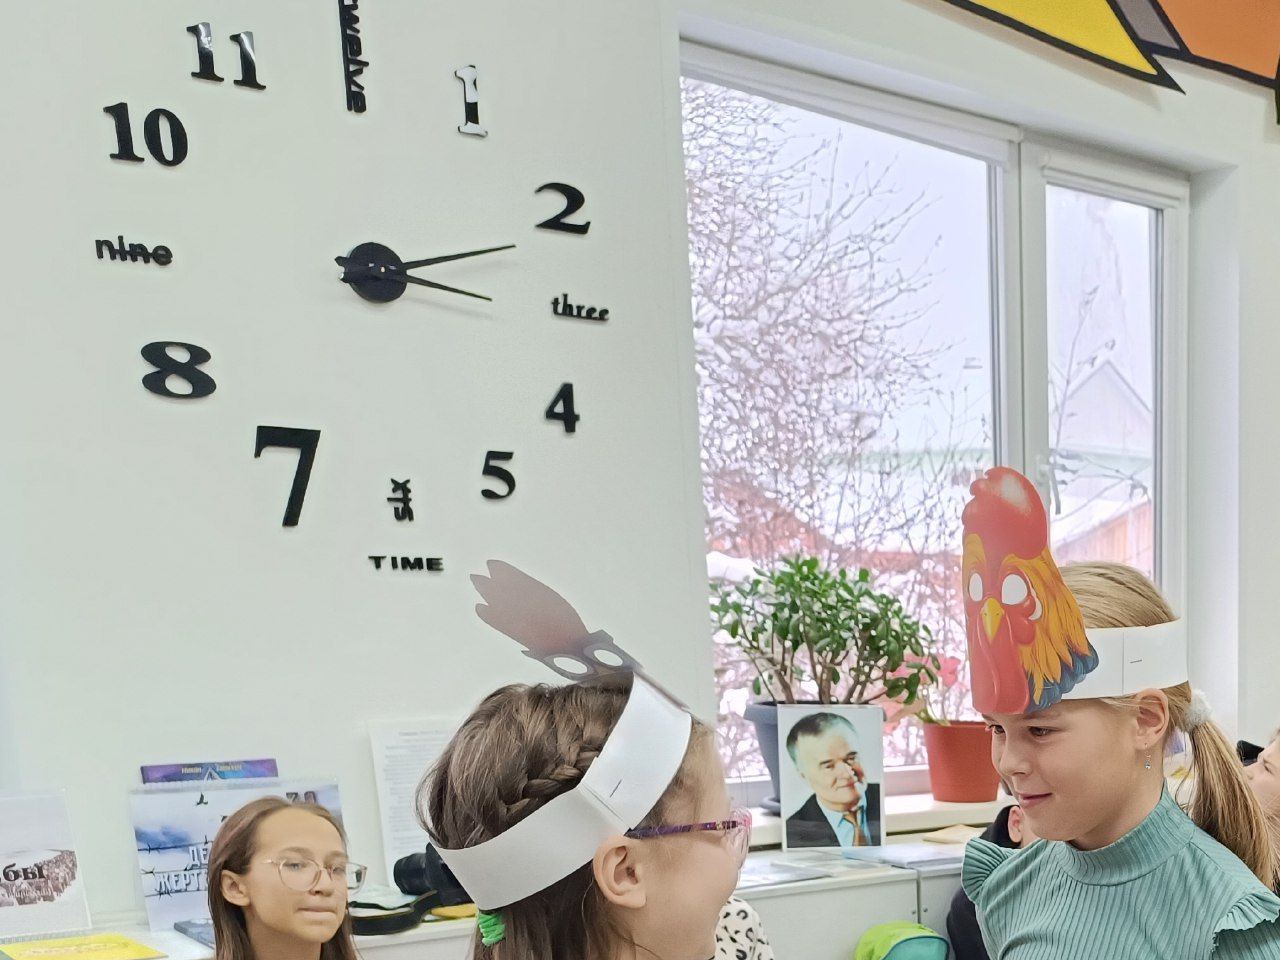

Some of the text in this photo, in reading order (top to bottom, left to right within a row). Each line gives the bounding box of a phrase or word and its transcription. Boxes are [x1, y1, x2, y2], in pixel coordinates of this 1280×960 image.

[186, 22, 266, 90] 11
[338, 0, 369, 113] welve
[454, 64, 488, 138] 1
[103, 102, 188, 166] 10
[534, 182, 591, 234] 2
[95, 236, 173, 267] nine
[551, 294, 610, 322] three
[141, 341, 217, 399] 8
[545, 383, 580, 433] 4
[254, 425, 321, 528] 7
[481, 451, 516, 500] 5
[368, 555, 444, 571] TIME
[0, 863, 46, 882] бы
[189, 845, 209, 868] ДЕ
[157, 869, 209, 895] ЖЕРТ
